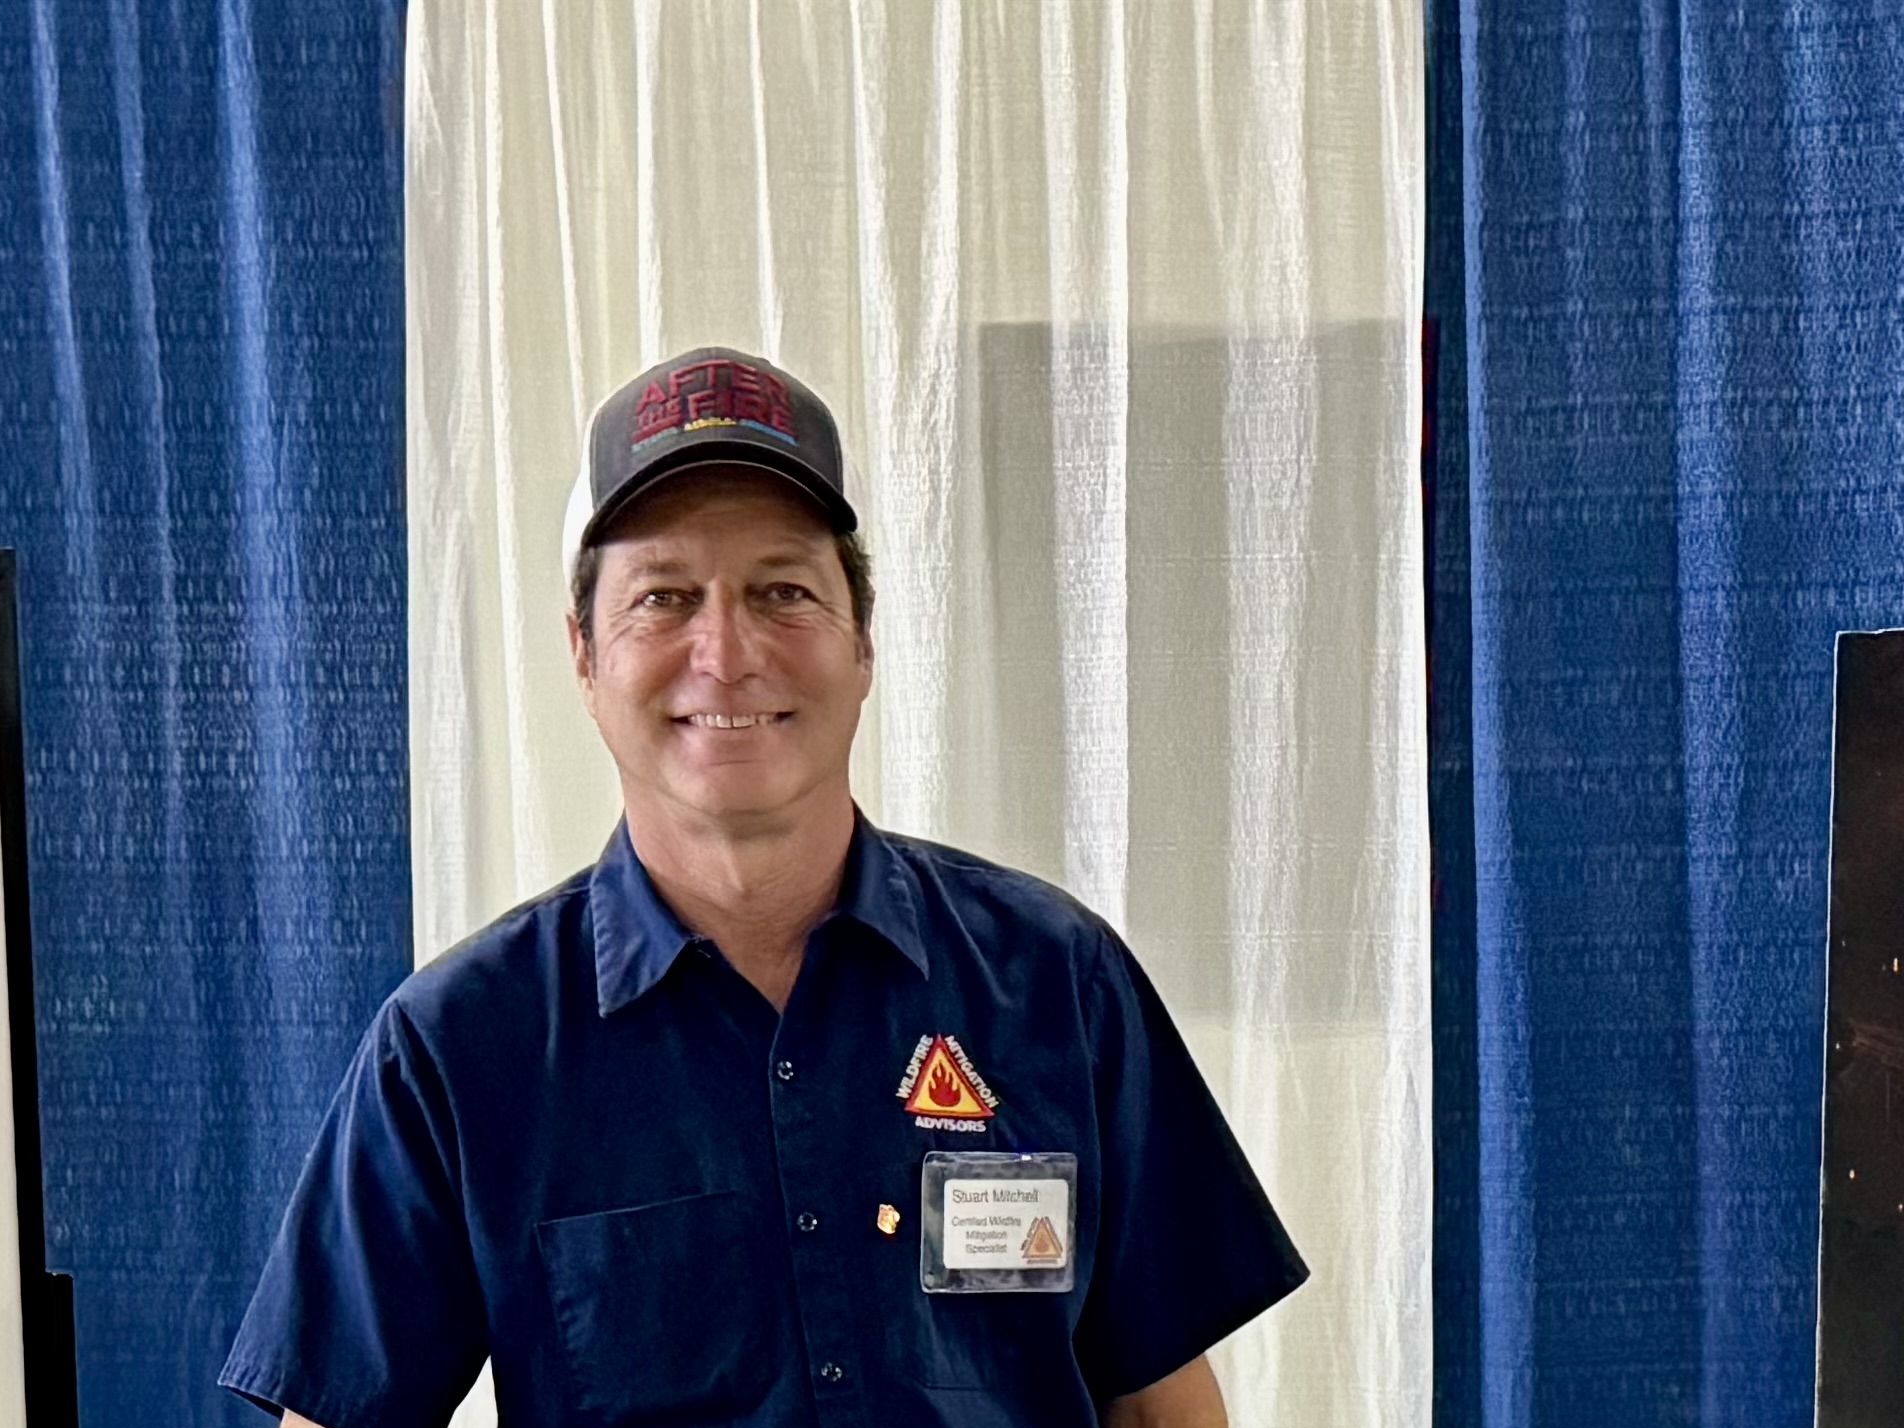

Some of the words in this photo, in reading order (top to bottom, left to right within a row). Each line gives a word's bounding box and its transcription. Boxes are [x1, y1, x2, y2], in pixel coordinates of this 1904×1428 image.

[636, 359, 792, 412] AFTER
[896, 1035, 933, 1099] WILDFIRE
[946, 1035, 998, 1108] MITIGATION
[915, 1116, 986, 1132] ADVISORS
[952, 1190, 988, 1203] Stuart
